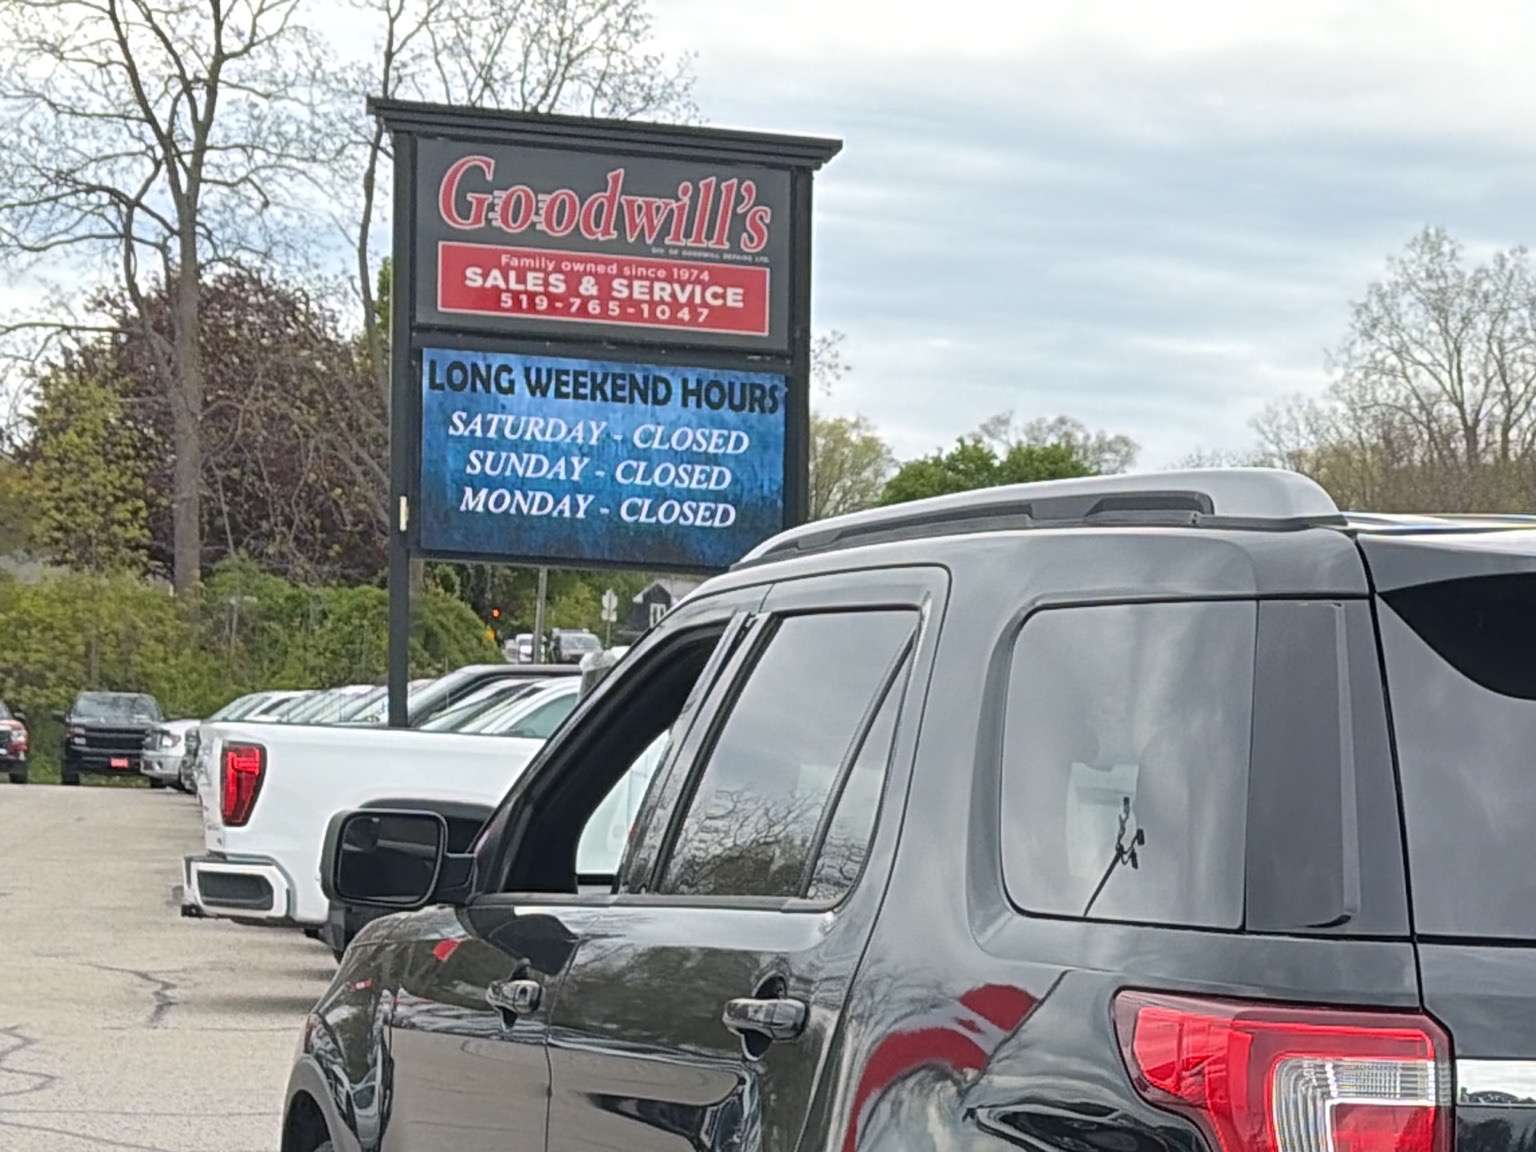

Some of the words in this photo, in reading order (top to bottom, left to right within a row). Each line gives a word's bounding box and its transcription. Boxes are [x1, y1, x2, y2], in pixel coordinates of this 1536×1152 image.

[438, 155, 771, 253] Goodwill's
[464, 266, 567, 294] SALES
[579, 275, 599, 297] &
[612, 278, 744, 308] SERVICE
[501, 253, 555, 272] Family
[561, 260, 618, 274] owned
[624, 263, 667, 279] since
[673, 267, 710, 282] 1974
[500, 293, 710, 323] 519-765-1047
[428, 359, 516, 396] LONG
[524, 365, 673, 406] WEEKEND
[681, 381, 784, 415] HOURS
[448, 411, 608, 444] SATURDAY
[632, 424, 751, 455] CLOSED
[465, 450, 590, 481] SUNDAY
[615, 460, 732, 490] CLOSED
[459, 487, 596, 519] MONDAY
[619, 498, 737, 528] CLOSED
